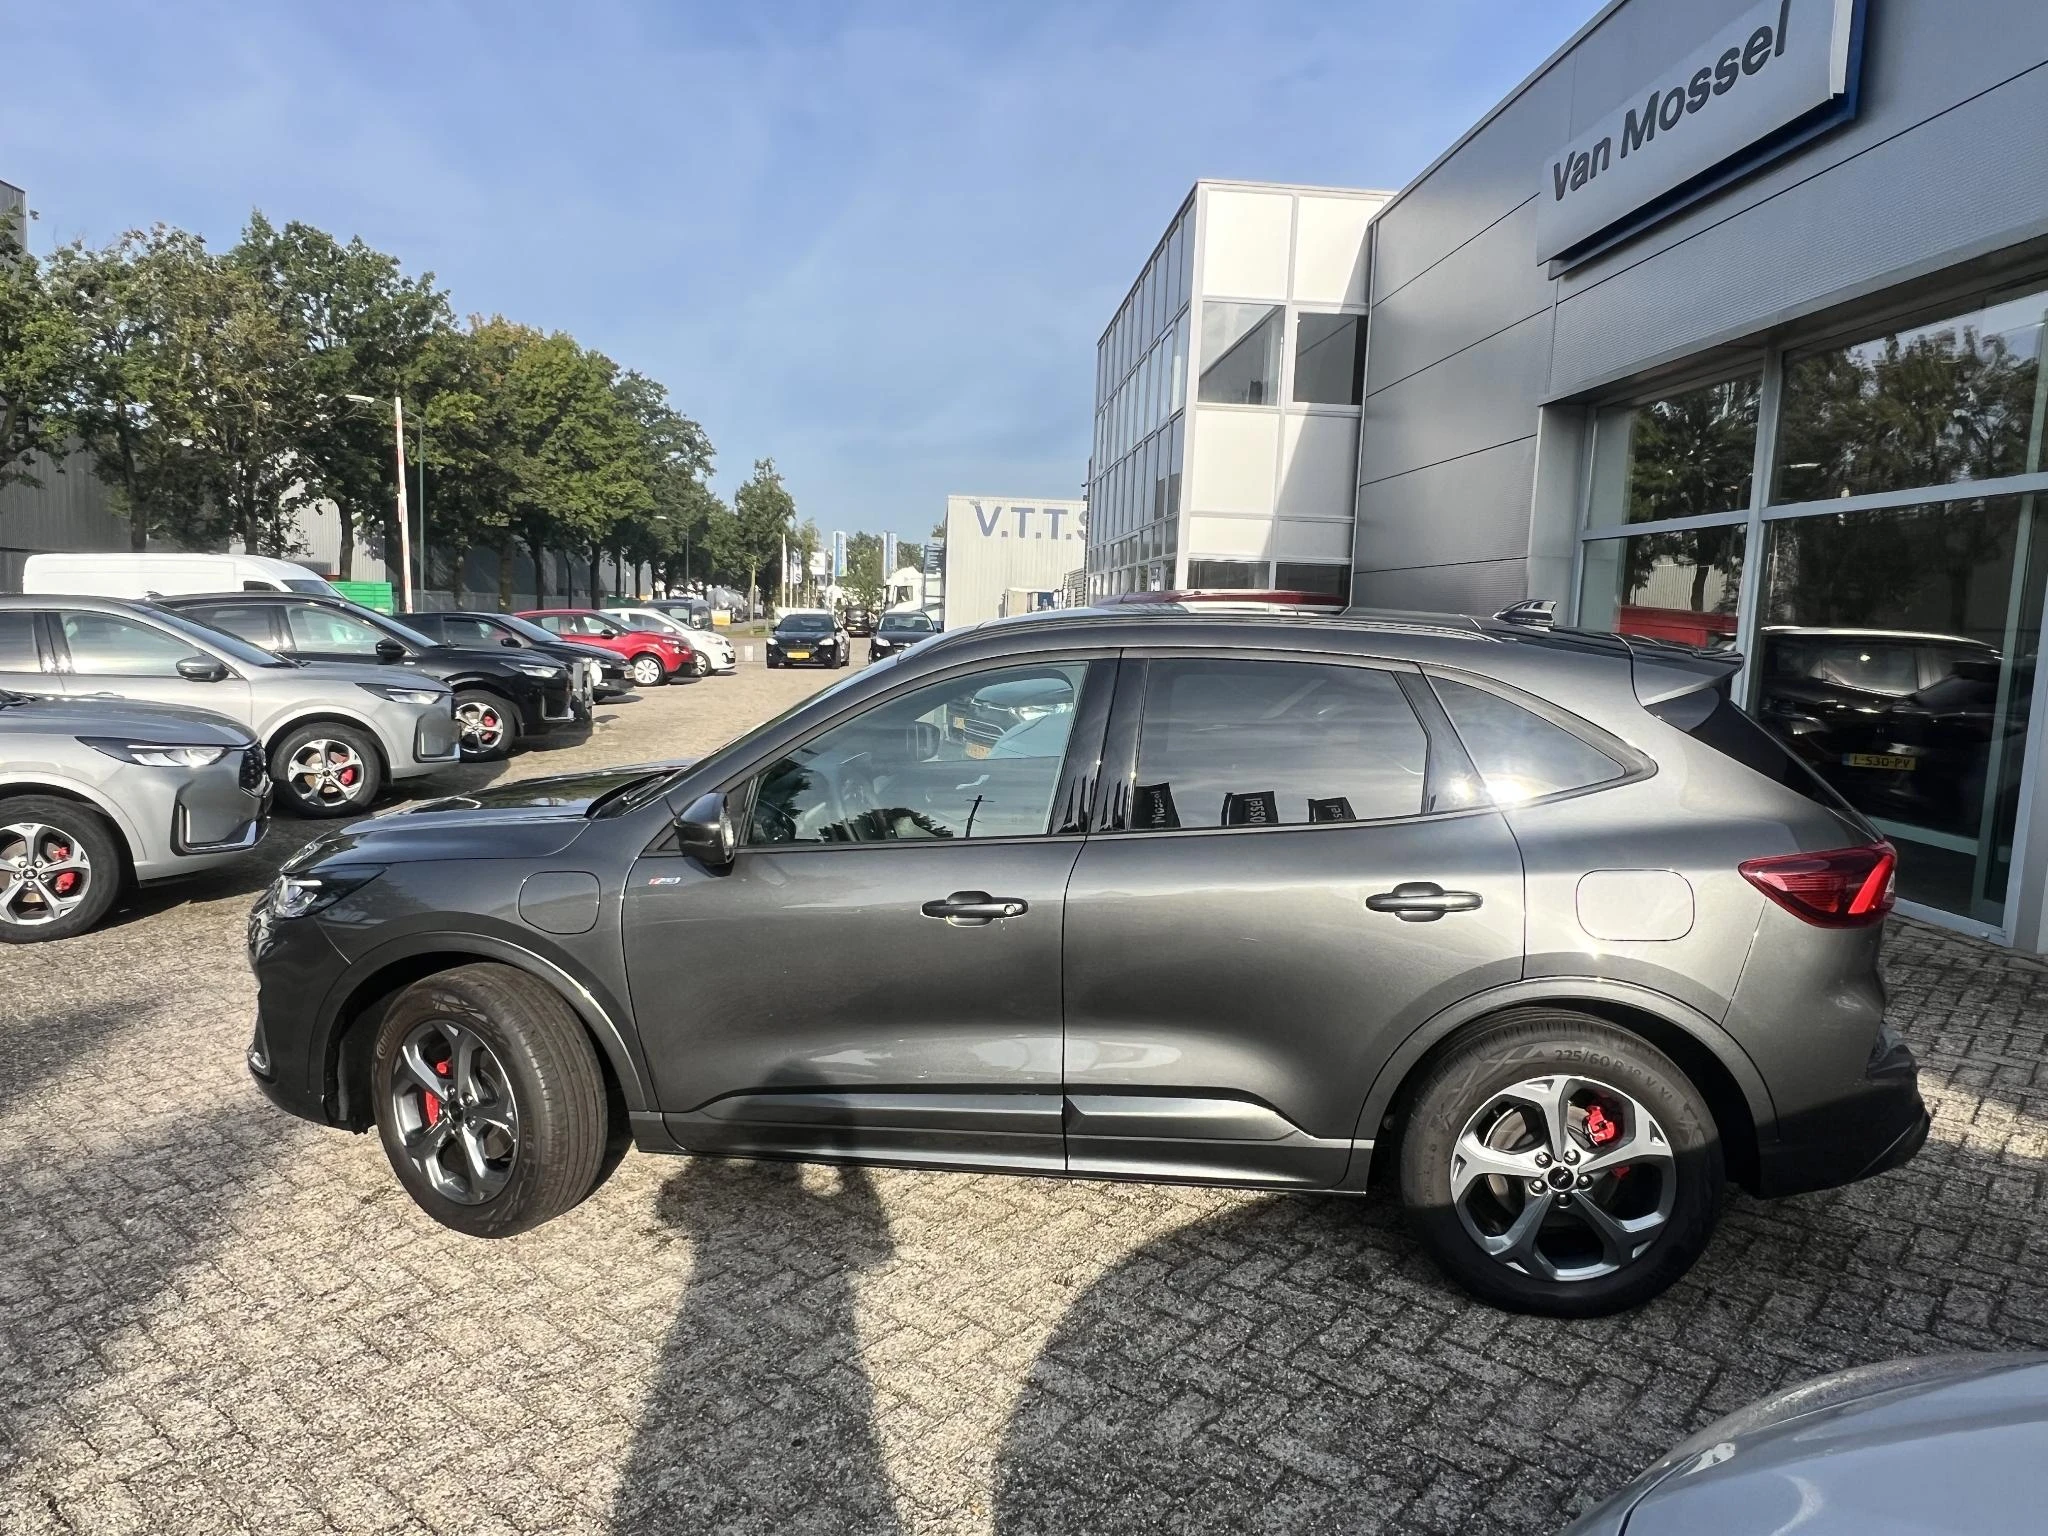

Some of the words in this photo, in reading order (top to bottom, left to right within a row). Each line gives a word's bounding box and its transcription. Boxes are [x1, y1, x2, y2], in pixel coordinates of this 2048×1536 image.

[1553, 136, 1612, 202] Van
[1620, 0, 1792, 159] Mossel
[1244, 797, 1267, 823] ossel
[1554, 1049, 1611, 1068] 225/60
